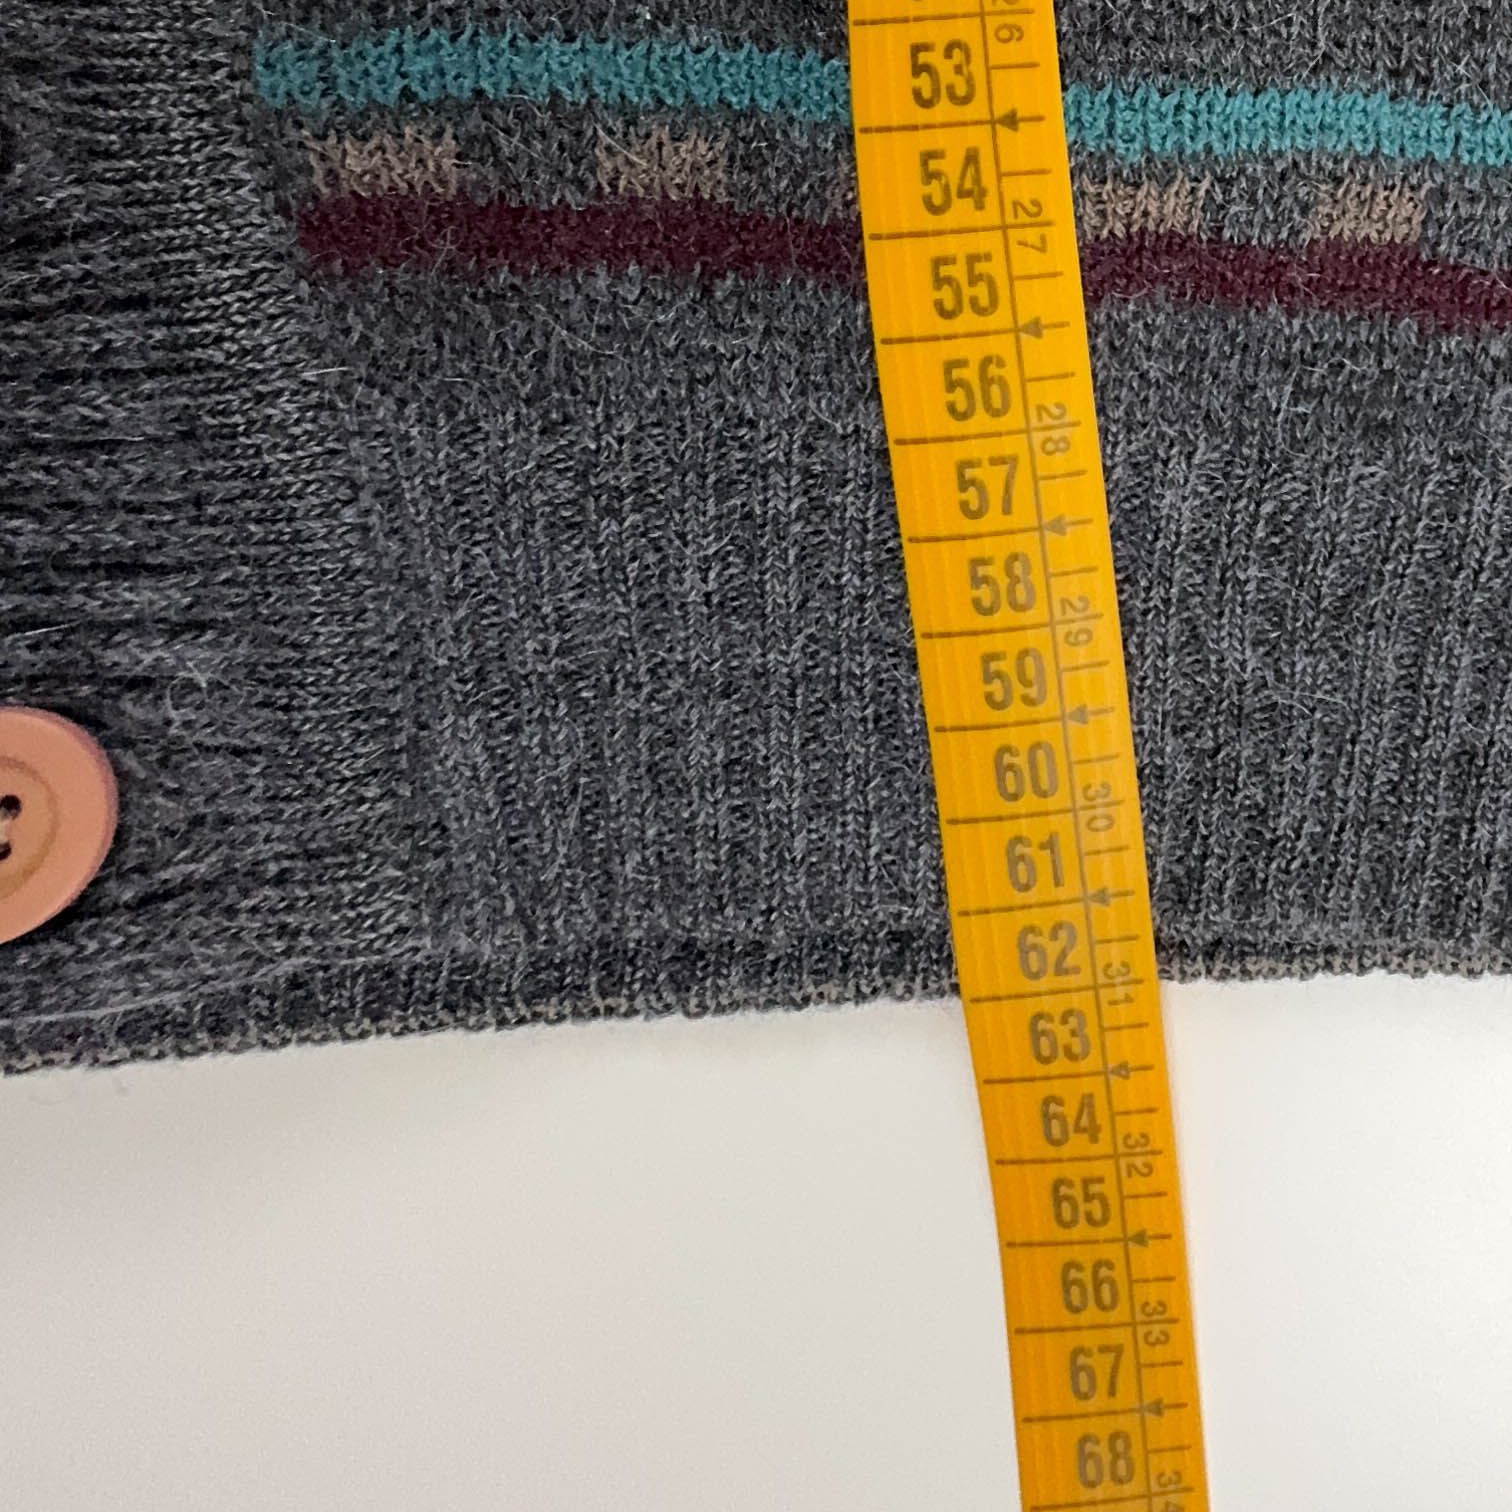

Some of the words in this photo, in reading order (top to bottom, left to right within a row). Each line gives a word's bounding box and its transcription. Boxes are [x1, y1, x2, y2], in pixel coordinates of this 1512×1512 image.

[909, 38, 976, 110] 53
[919, 146, 989, 216] 54
[1012, 198, 1048, 254] 27
[930, 251, 1000, 321] 55
[942, 354, 1012, 422] 56
[1036, 402, 1071, 456] 28
[954, 454, 1019, 520] 57
[968, 552, 1036, 617] 58
[1060, 596, 1093, 647] 29
[980, 648, 1047, 712] 59
[993, 740, 1059, 803] 60
[1082, 782, 1115, 832] 30
[1005, 832, 1064, 893] 61
[1016, 920, 1081, 981] 62
[1102, 960, 1134, 1006] 31
[1028, 1008, 1091, 1065] 63
[1040, 1092, 1102, 1148] 64
[1122, 1132, 1153, 1178] 32
[1051, 1176, 1111, 1230] 65
[1061, 1259, 1120, 1315] 66
[1140, 1300, 1170, 1347] 33
[1069, 1344, 1124, 1402] 67
[1076, 1430, 1135, 1490] 68
